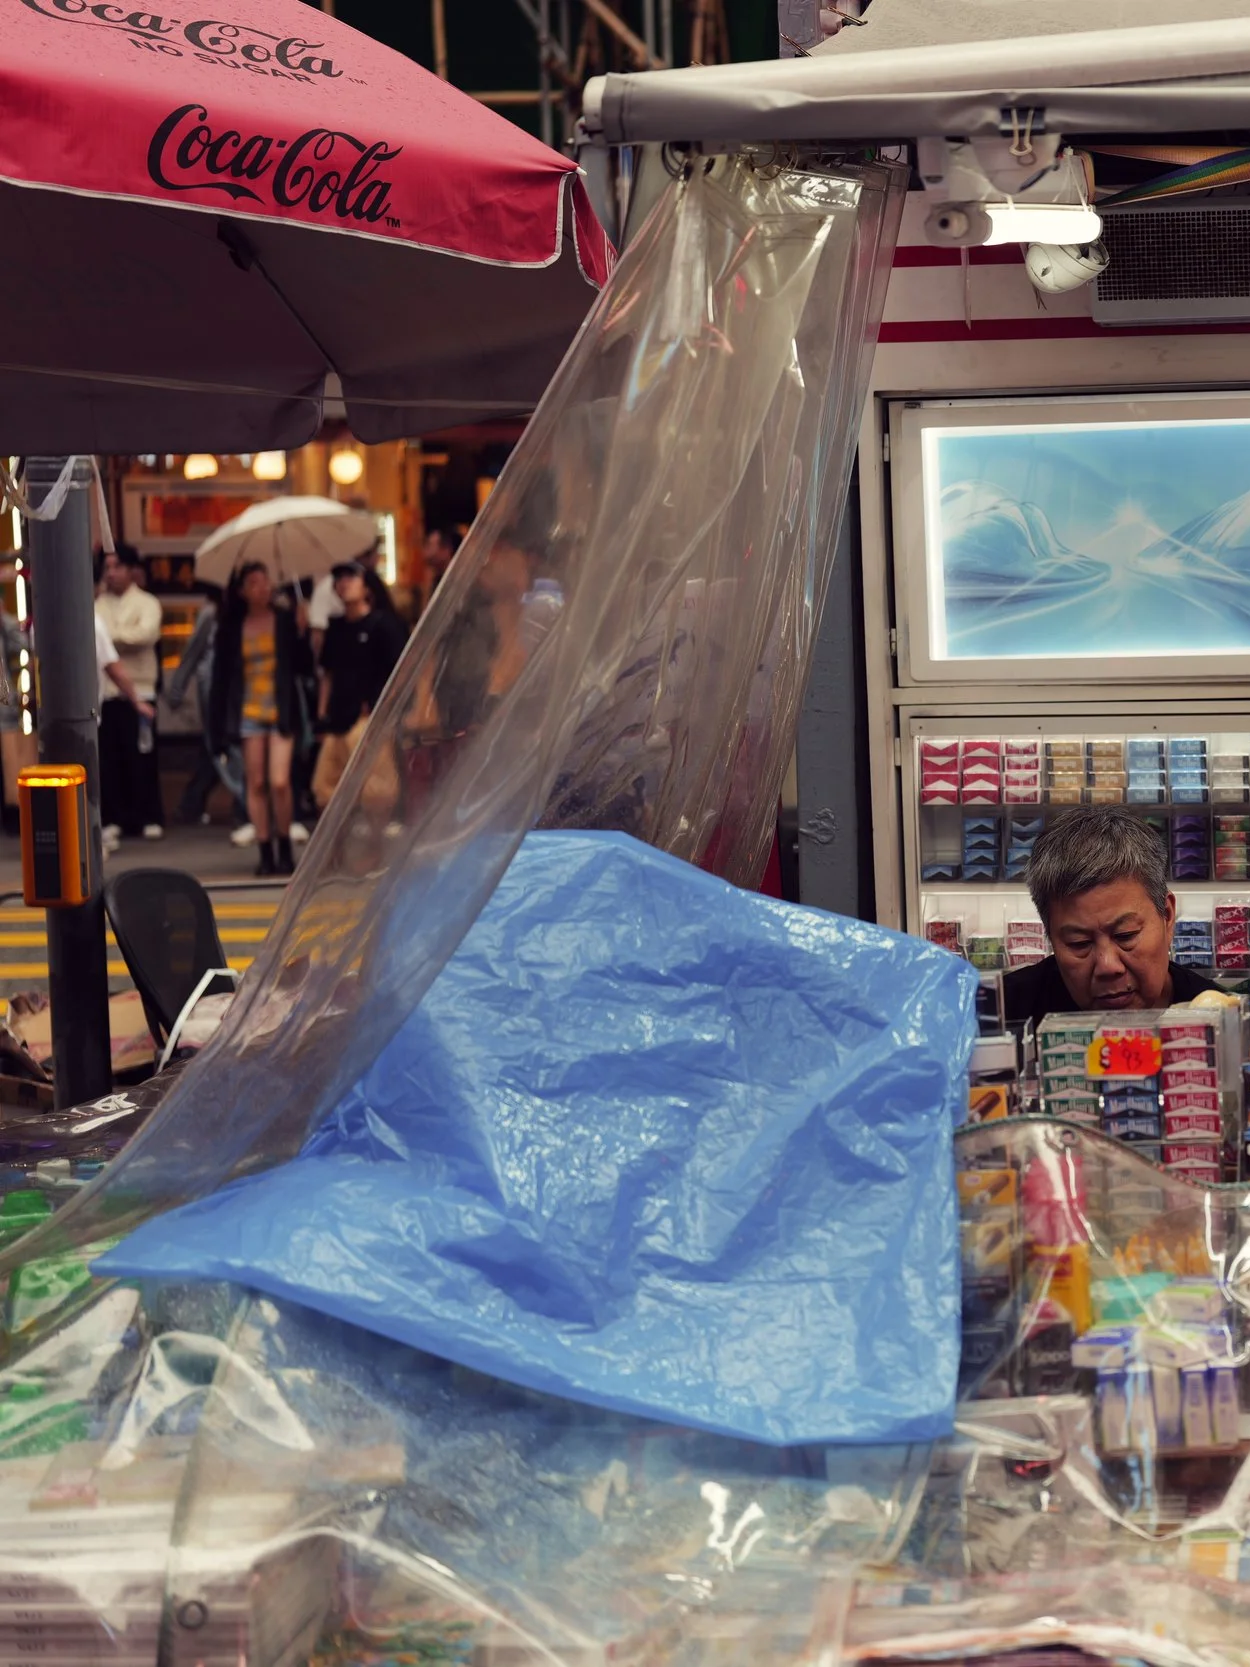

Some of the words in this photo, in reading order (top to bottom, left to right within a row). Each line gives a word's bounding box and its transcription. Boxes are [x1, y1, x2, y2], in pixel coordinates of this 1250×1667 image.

[128, 37, 185, 58] NO
[198, 53, 319, 85] SUGAR
[147, 104, 404, 223] Coca-Cola
[1219, 907, 1245, 921] NEXT
[1221, 923, 1246, 937] NEXT
[1220, 938, 1246, 952] NEXT
[1219, 955, 1244, 969] NEXT
[1121, 1047, 1143, 1071] 93
